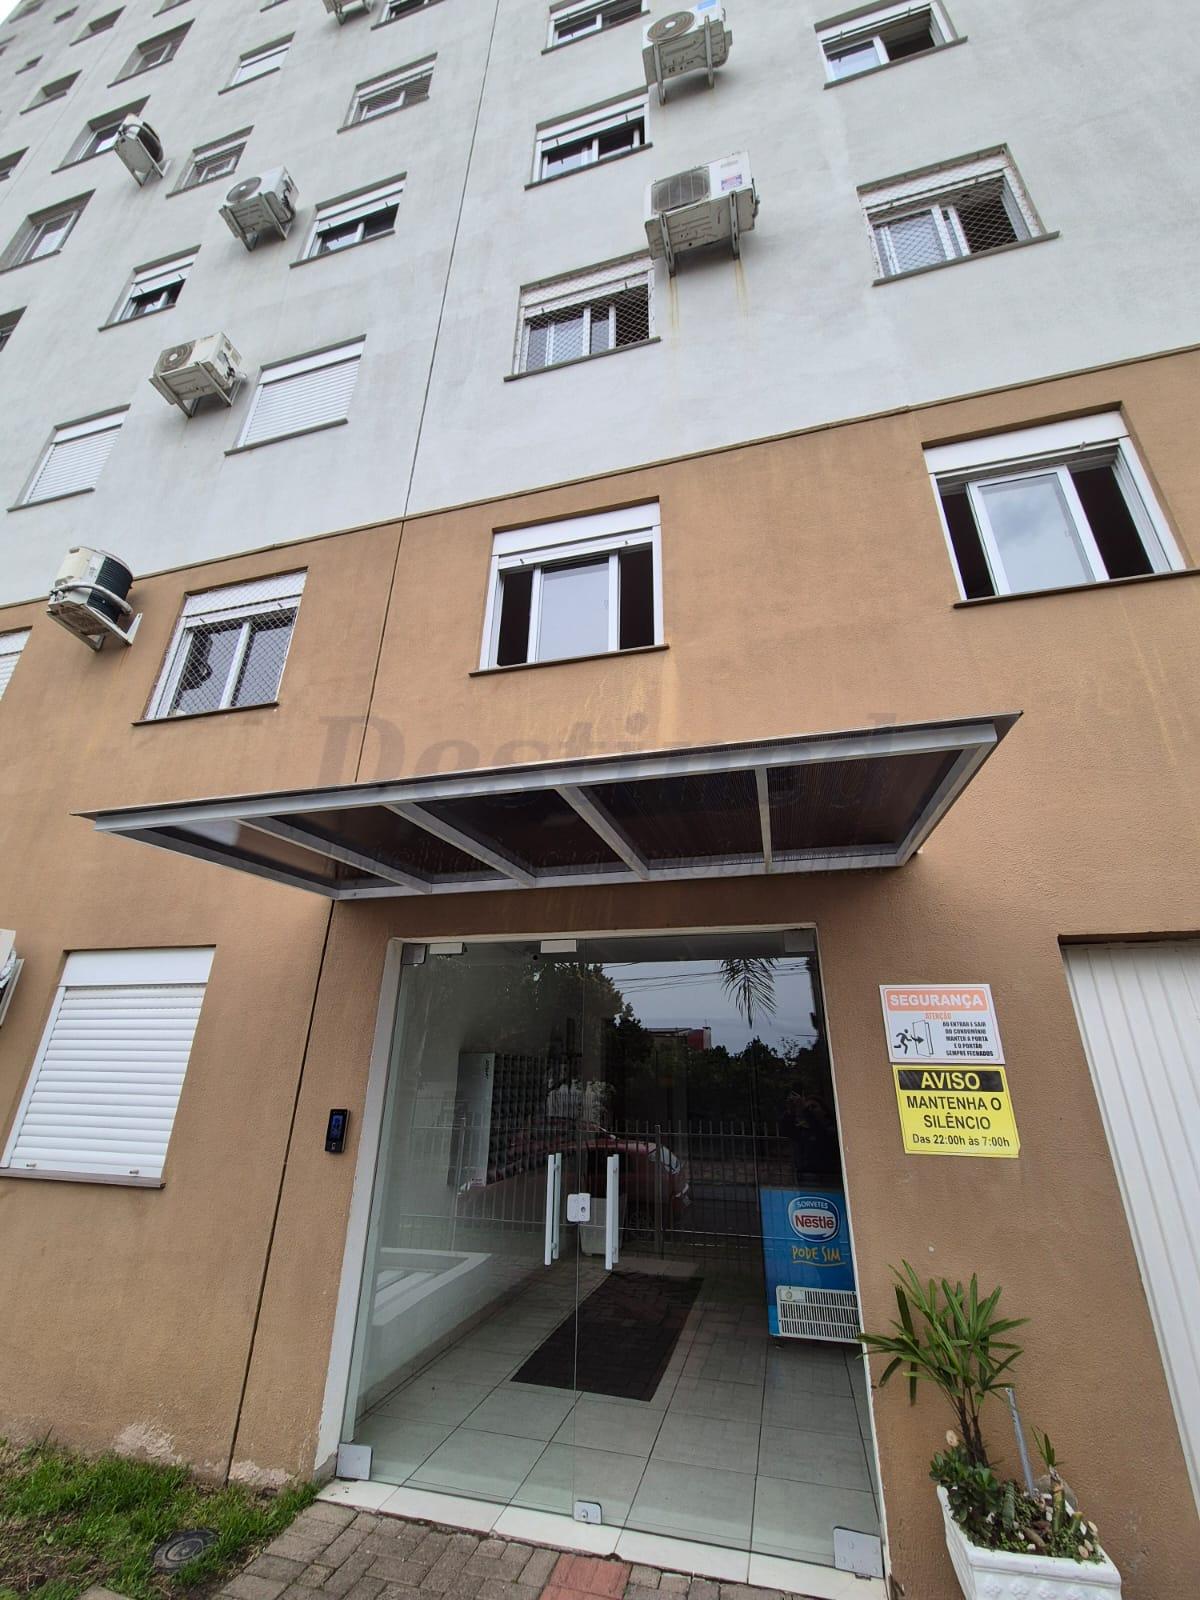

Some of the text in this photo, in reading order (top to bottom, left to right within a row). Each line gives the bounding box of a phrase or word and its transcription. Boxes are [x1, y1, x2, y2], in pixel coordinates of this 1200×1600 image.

[889, 994, 984, 1008] SEGURANÇA
[921, 1072, 980, 1090] AVISO
[907, 1096, 1002, 1111] MANTENHA O
[924, 1112, 991, 1130] SILÊNCIO
[912, 1133, 931, 1144] Das
[933, 1134, 966, 1145] 22:00h
[982, 1136, 1010, 1147] 7:00h
[796, 1200, 828, 1209] SORVETES
[791, 1245, 841, 1262] PODE SIM
